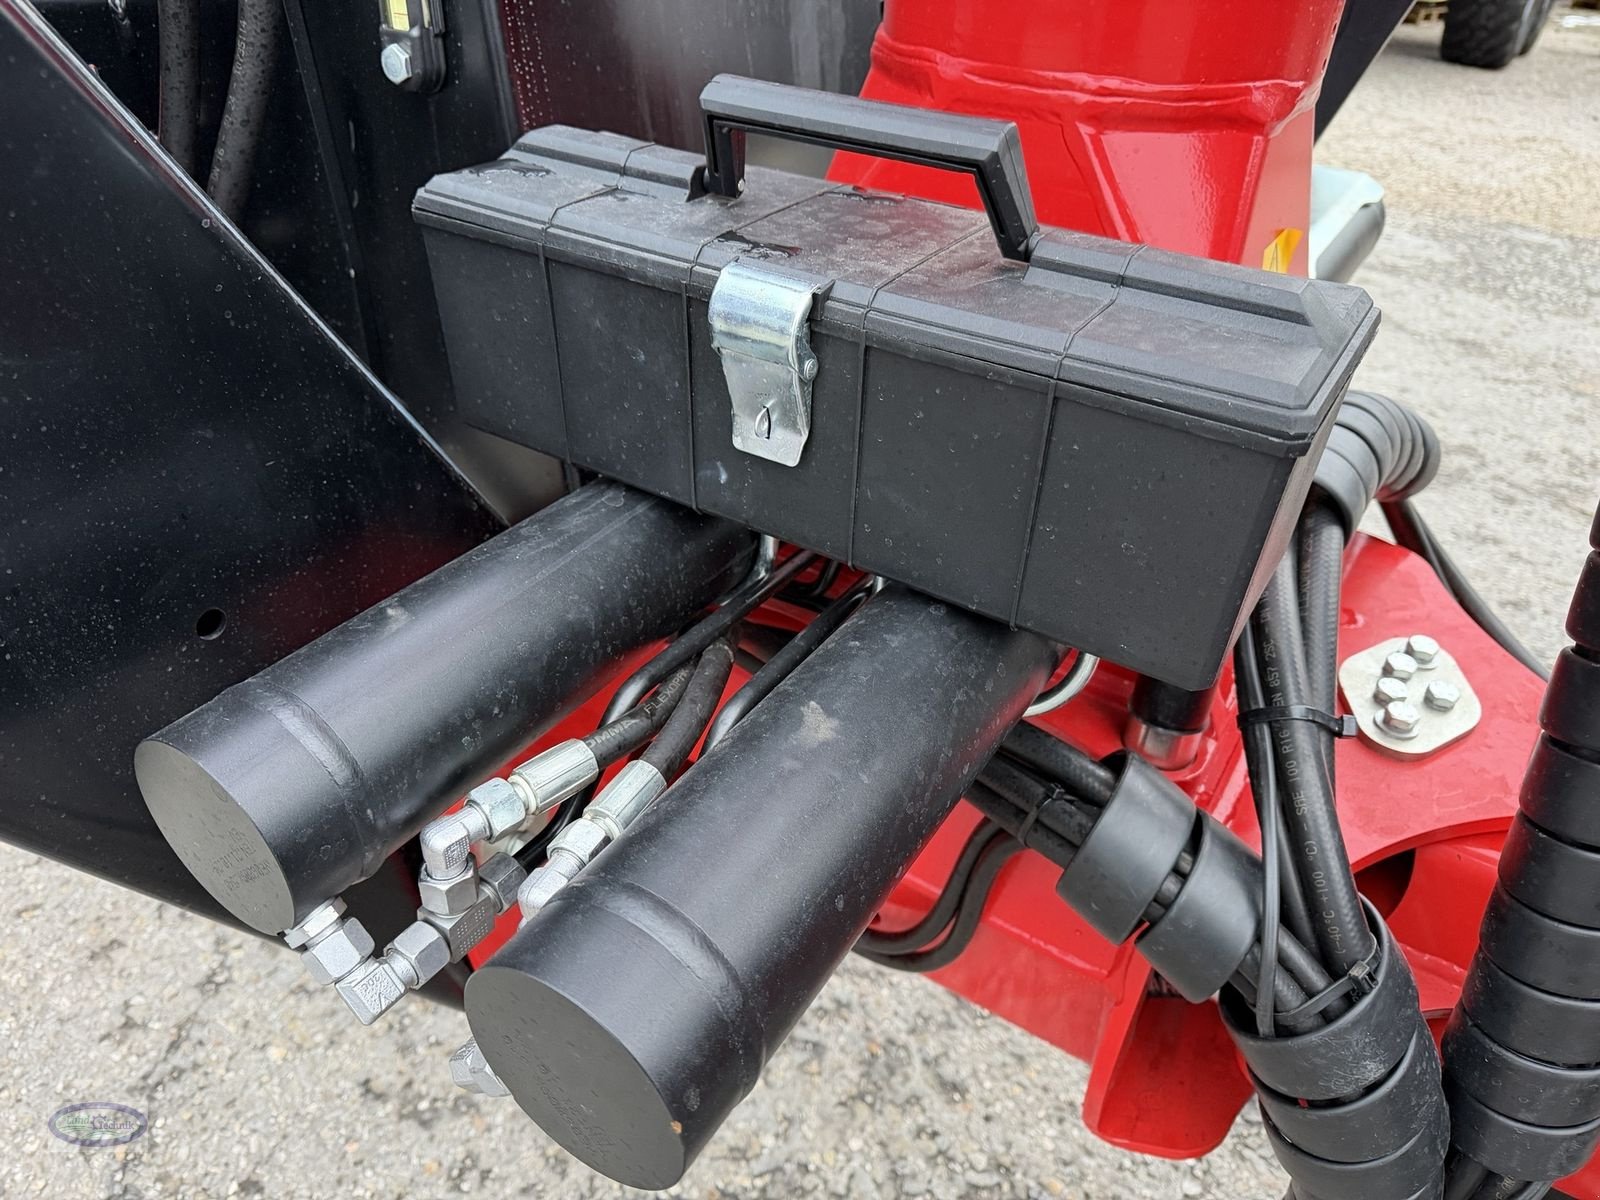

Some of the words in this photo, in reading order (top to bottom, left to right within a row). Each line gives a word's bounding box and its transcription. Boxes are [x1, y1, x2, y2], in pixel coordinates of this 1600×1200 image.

[1263, 639, 1277, 661] 2SC
[1266, 666, 1281, 688] 857
[1278, 729, 1294, 754] R16
[1284, 760, 1300, 783] 100
[1291, 790, 1308, 816] SAE
[1312, 871, 1329, 903] +100
